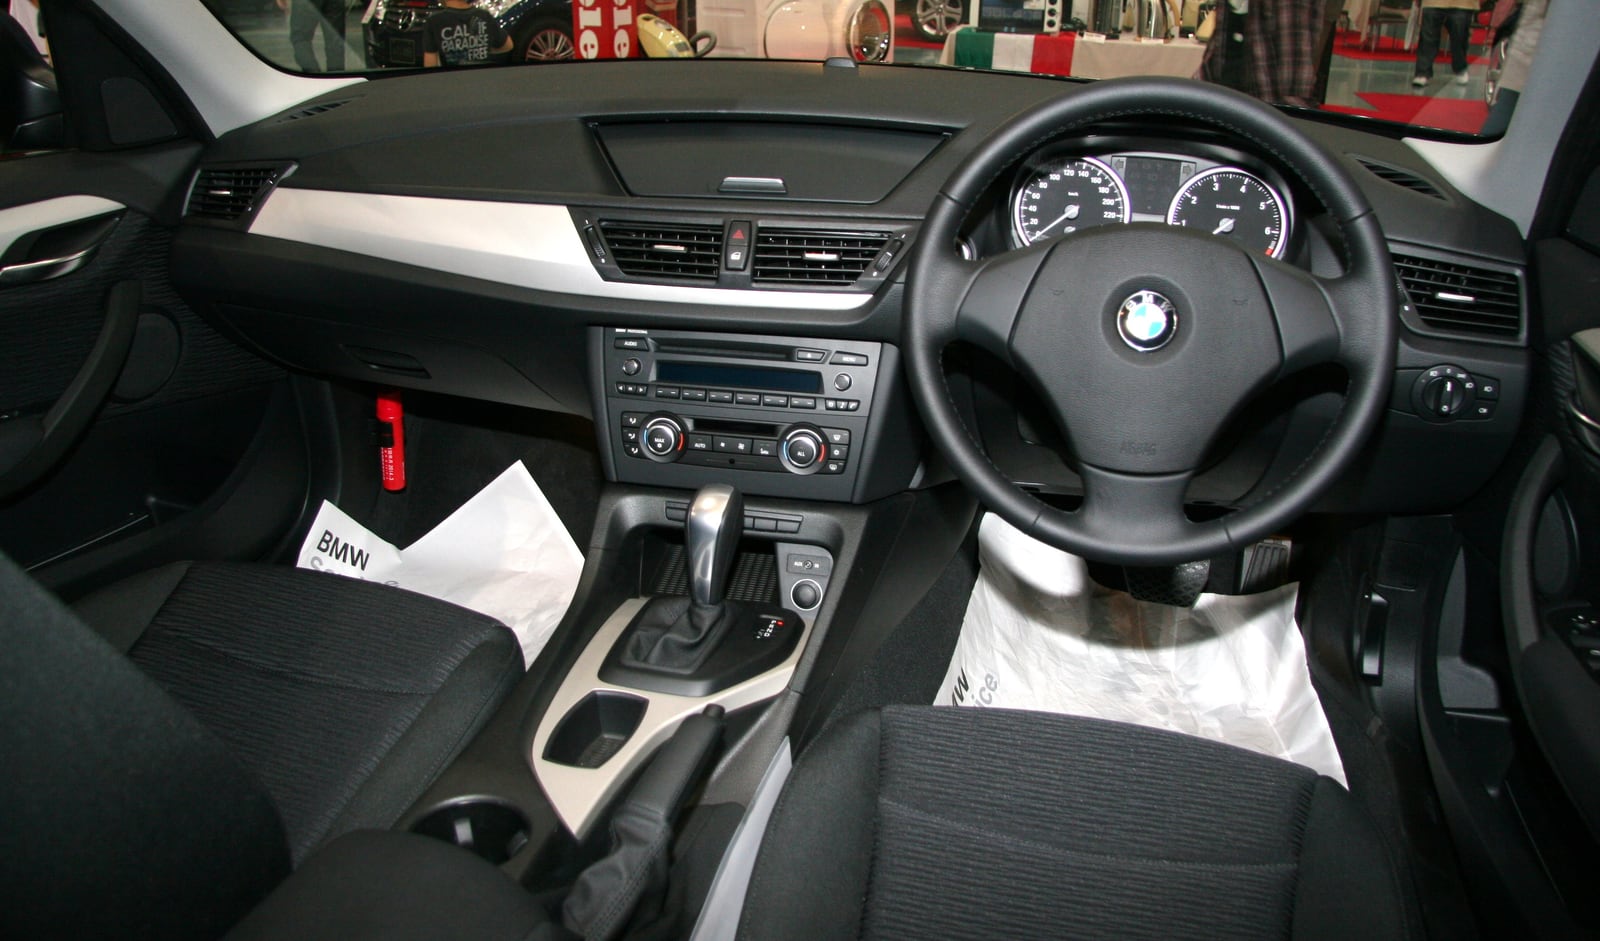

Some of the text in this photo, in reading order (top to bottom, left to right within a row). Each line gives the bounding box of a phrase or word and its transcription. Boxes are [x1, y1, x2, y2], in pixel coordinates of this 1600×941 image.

[579, 0, 602, 59] le
[613, 0, 632, 58] le
[442, 34, 489, 53] PARADISE
[468, 47, 488, 60] FREE
[1049, 173, 1061, 181] 100
[1063, 169, 1075, 177] 120
[1077, 170, 1089, 178] 140
[1038, 181, 1048, 189] 80
[1212, 182, 1219, 191] 3
[1239, 184, 1247, 193] 4
[1031, 192, 1041, 200] 60
[1190, 195, 1198, 205] 2
[1102, 197, 1115, 206] 200
[1259, 201, 1266, 210] 5
[1028, 204, 1038, 212] 40
[1103, 211, 1116, 219] 220
[1029, 217, 1039, 225] 20
[1264, 226, 1271, 235] 6
[1125, 292, 1174, 312] BMW
[797, 450, 806, 458] ALL
[316, 529, 370, 572] BMW
